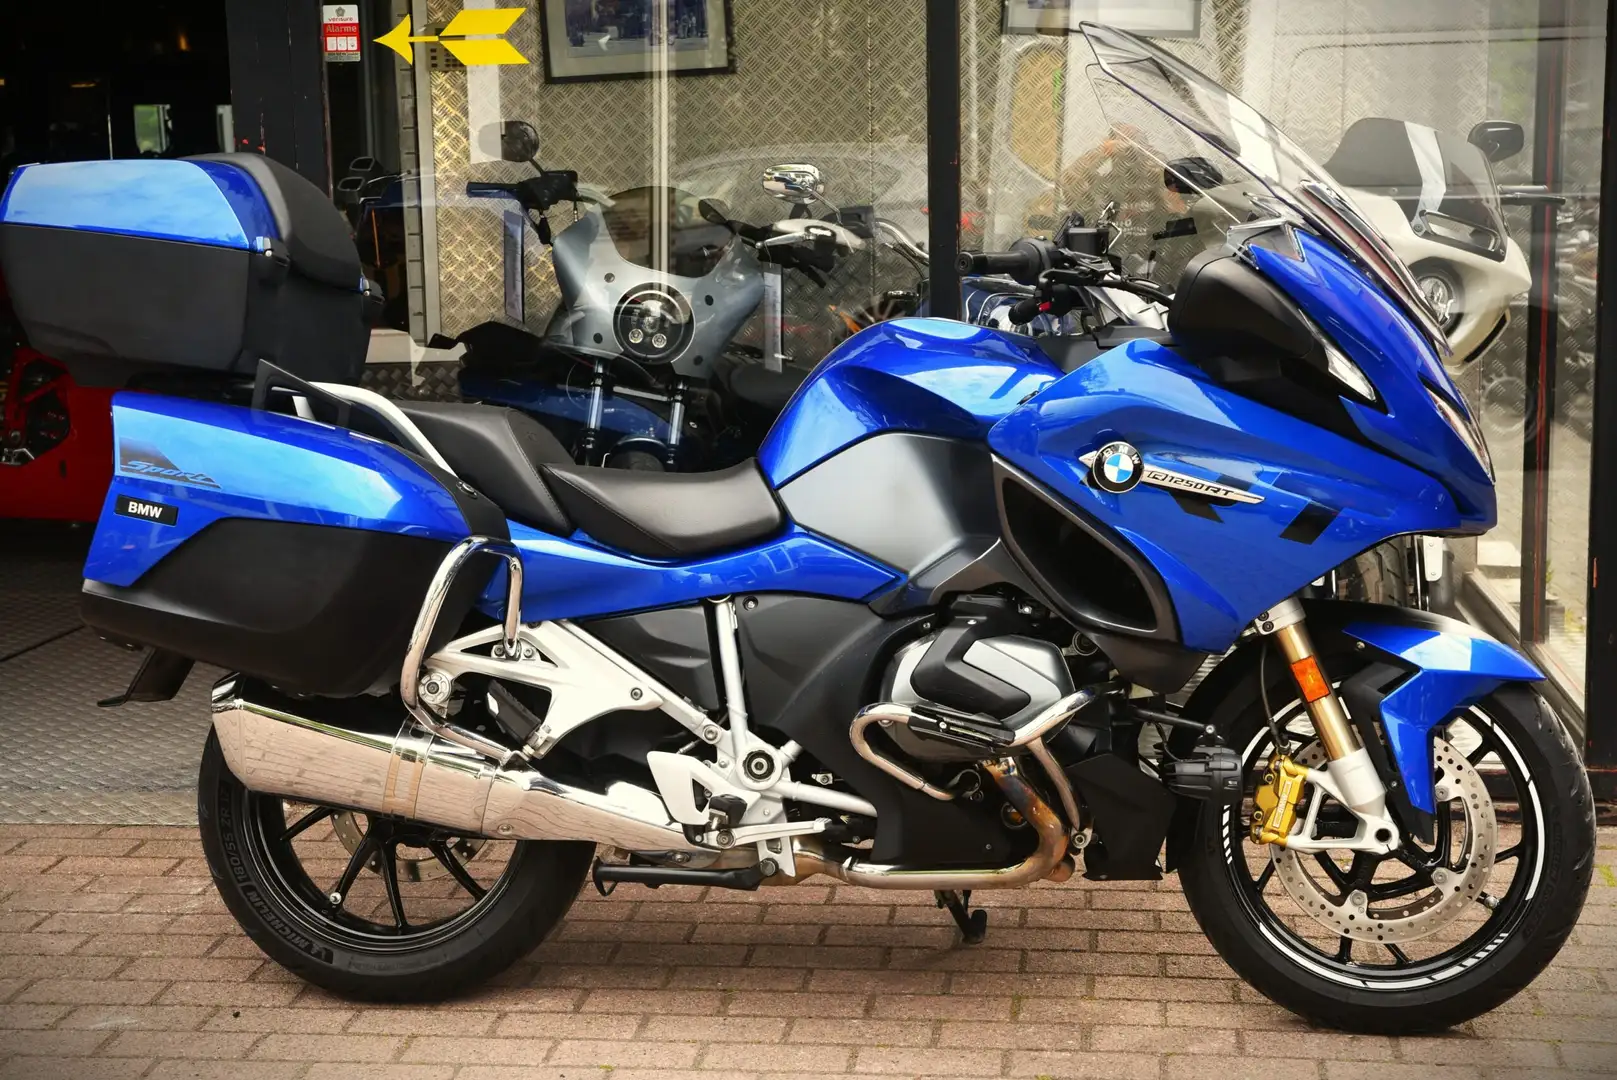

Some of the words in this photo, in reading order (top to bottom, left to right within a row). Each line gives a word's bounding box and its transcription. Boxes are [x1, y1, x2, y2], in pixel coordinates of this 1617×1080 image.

[326, 24, 357, 33] Alarme
[1102, 445, 1142, 465] BMW
[120, 460, 216, 483] Sport
[128, 501, 163, 519] BMW
[224, 833, 247, 881] 180/55
[247, 889, 309, 950] MICHELIN
